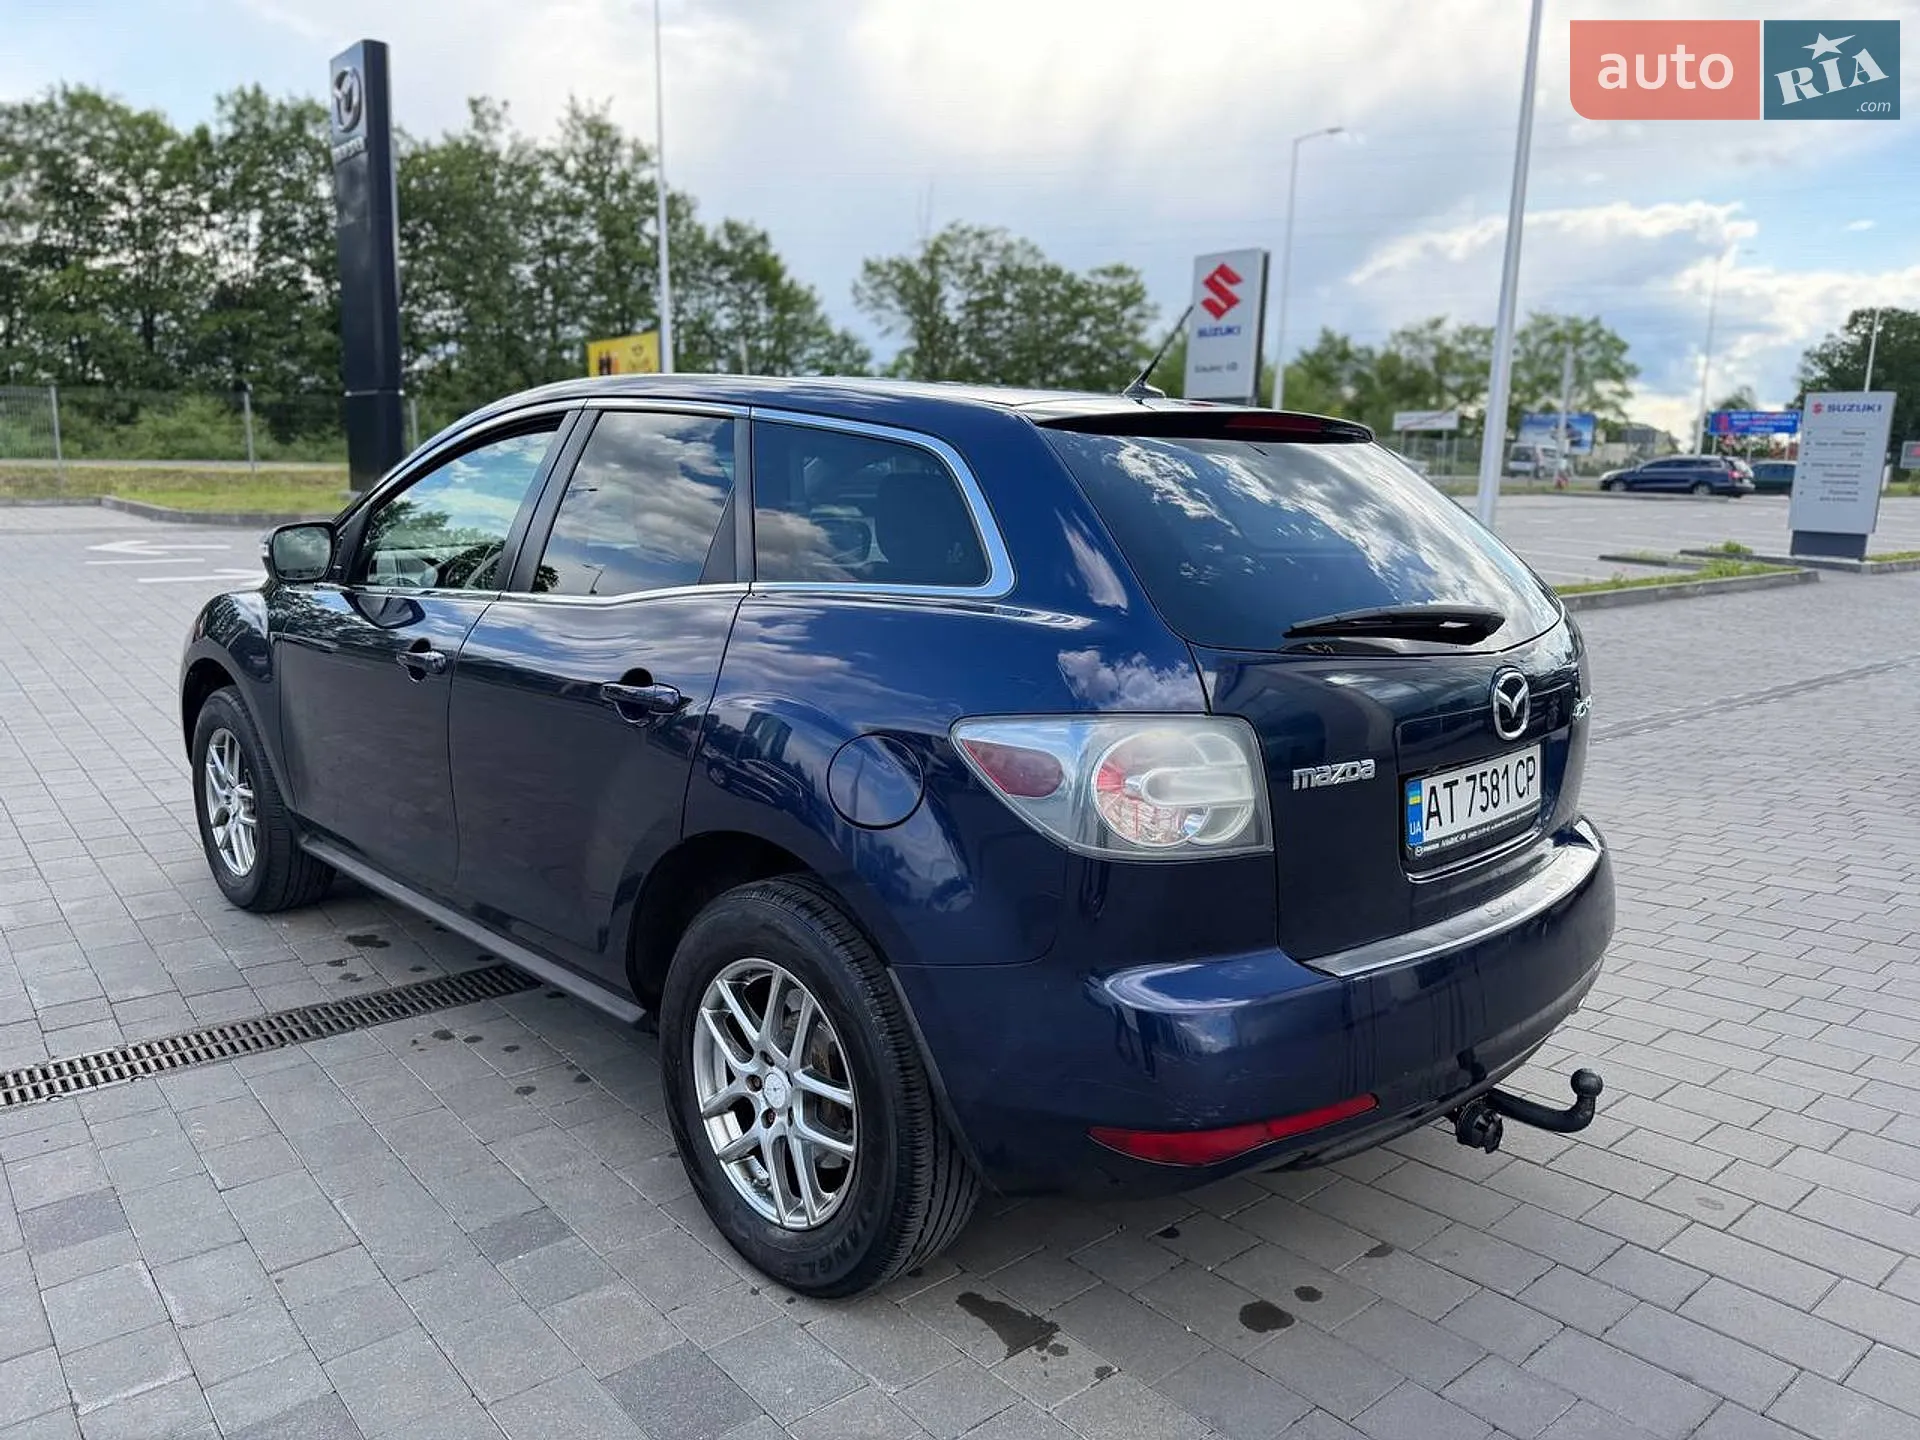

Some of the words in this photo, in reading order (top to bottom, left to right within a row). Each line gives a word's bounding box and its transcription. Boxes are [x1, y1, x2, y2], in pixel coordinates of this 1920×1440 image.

[1198, 325, 1241, 338] SUZUKI
[1826, 402, 1882, 414] SUZUKI
[1292, 758, 1376, 790] mazda
[1425, 779, 1459, 831] AT
[1465, 763, 1511, 818] 7581
[1515, 755, 1536, 799] CP
[1409, 820, 1422, 835] UA
